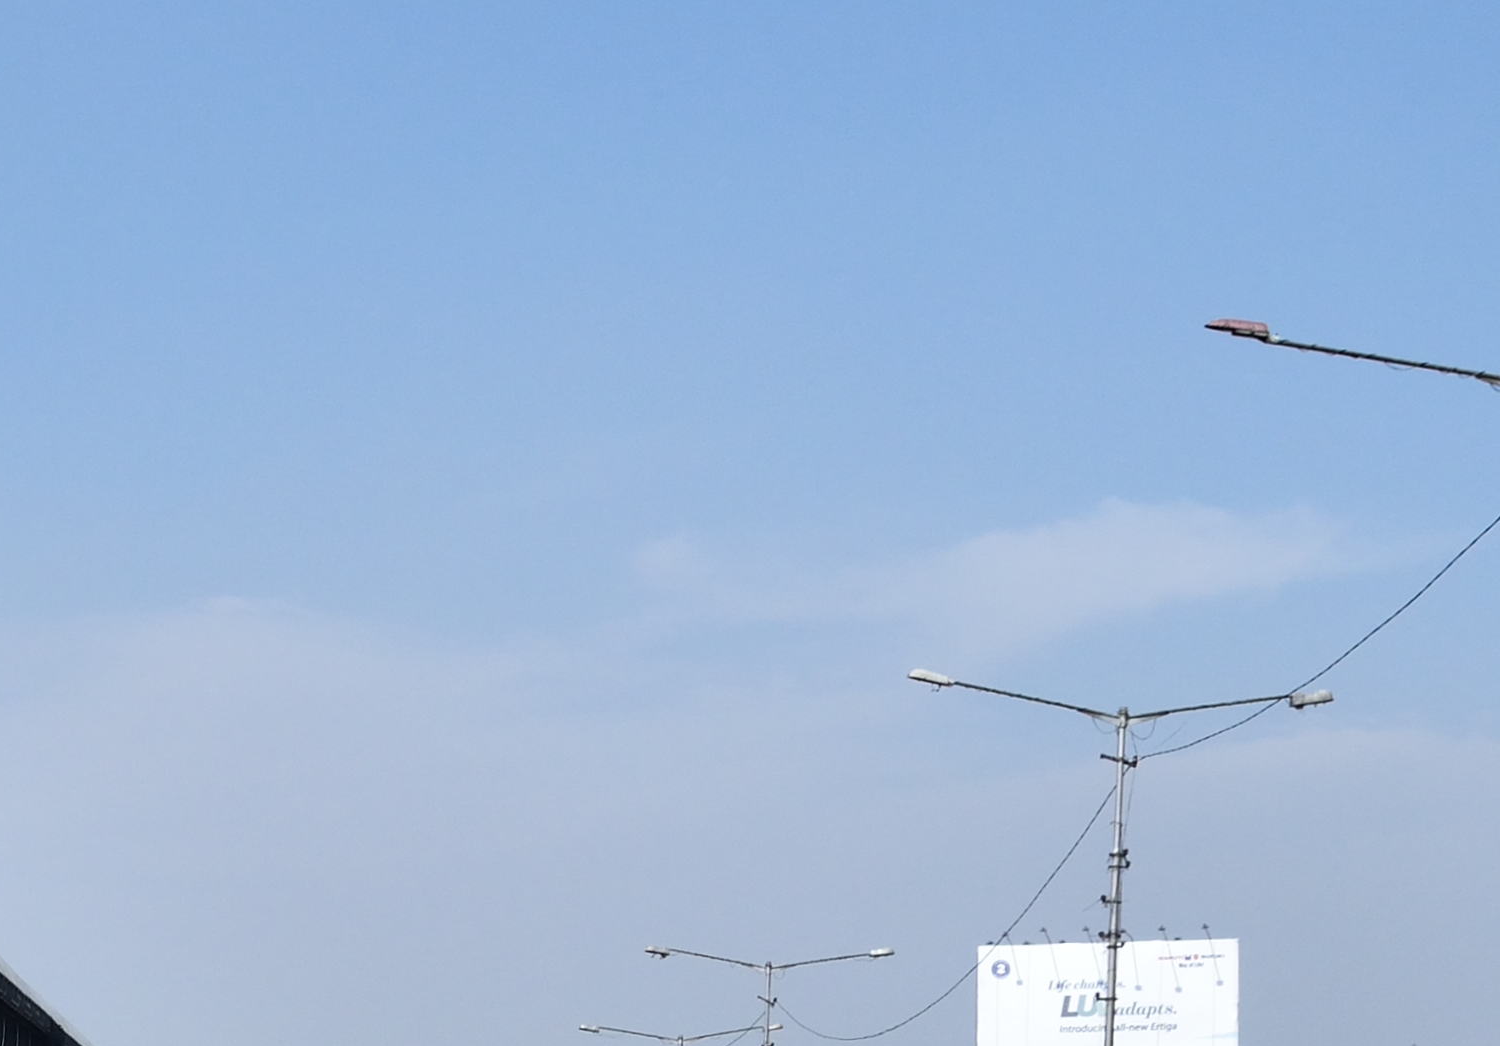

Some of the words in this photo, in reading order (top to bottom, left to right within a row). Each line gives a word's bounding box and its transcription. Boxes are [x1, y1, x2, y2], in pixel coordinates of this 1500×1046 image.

[1048, 980, 1071, 993] Life
[1060, 1024, 1107, 1034] Introducin
[1150, 1021, 1177, 1032] Ertiga
